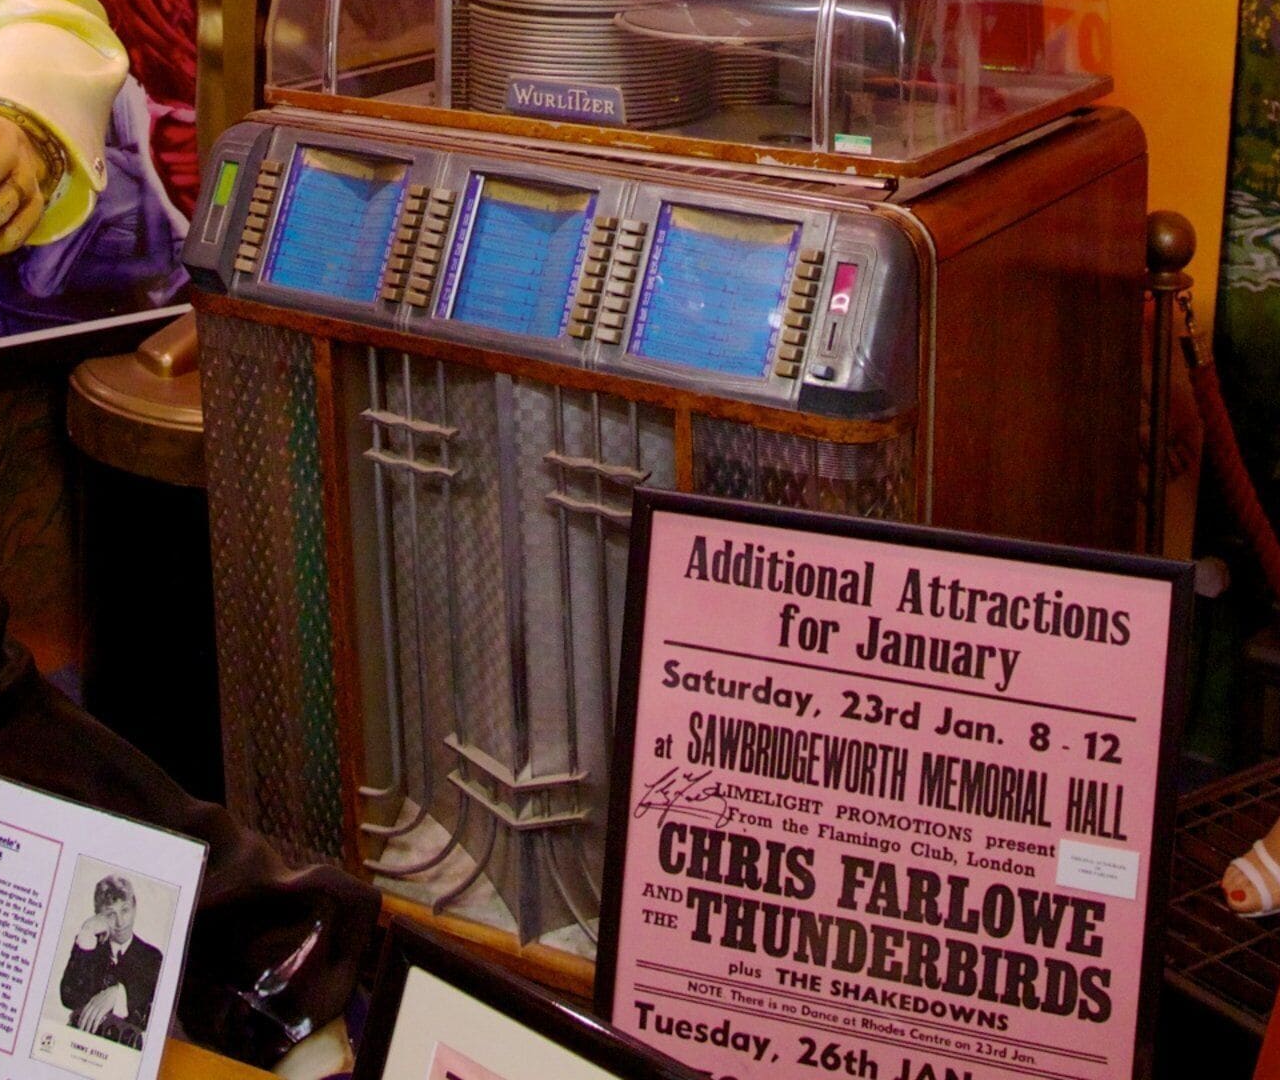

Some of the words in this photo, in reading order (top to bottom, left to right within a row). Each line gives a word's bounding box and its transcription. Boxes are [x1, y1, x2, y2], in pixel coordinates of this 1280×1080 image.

[684, 535, 876, 608] Additional
[896, 568, 1131, 647] Attractions
[778, 603, 840, 654] for
[856, 617, 1022, 693] January
[662, 659, 822, 719] Saturday,
[841, 689, 921, 731] 23rd
[934, 707, 1004, 746] Jan.
[1029, 723, 1051, 752] 8
[1083, 731, 1123, 764] 12
[654, 734, 673, 760] at
[687, 710, 908, 802] SAWBRIDGEWORTH
[920, 751, 1052, 829] MEMORIAL
[1065, 776, 1128, 842] HALL
[714, 782, 823, 816] LIMELIGHT
[835, 803, 973, 844] PROMOTIONS
[986, 835, 1056, 859] present
[727, 807, 773, 830] From
[782, 816, 809, 837] the
[818, 824, 902, 856] Flamingo
[910, 841, 959, 868] Club,
[967, 850, 1037, 879] London
[642, 882, 684, 905] AND
[642, 908, 678, 931] THE
[658, 822, 818, 901] CHRIS
[837, 853, 1107, 958] FARLOWE
[686, 888, 1113, 1024] THUNDERBIRDS
[728, 959, 762, 981] plus
[776, 968, 822, 994] THE
[829, 979, 1010, 1032] SHAKEDOWNS
[634, 1001, 781, 1064] Tuesday,
[797, 1037, 879, 1080] 26th
[731, 990, 765, 1008] There
[767, 997, 778, 1010] is
[781, 1001, 798, 1014] no
[801, 1004, 839, 1023] Dance
[842, 1014, 858, 1026] at
[860, 1017, 907, 1040] Rhodes
[909, 1028, 952, 1048] Centre
[955, 1039, 972, 1051] on
[975, 1040, 1008, 1060] 23rd
